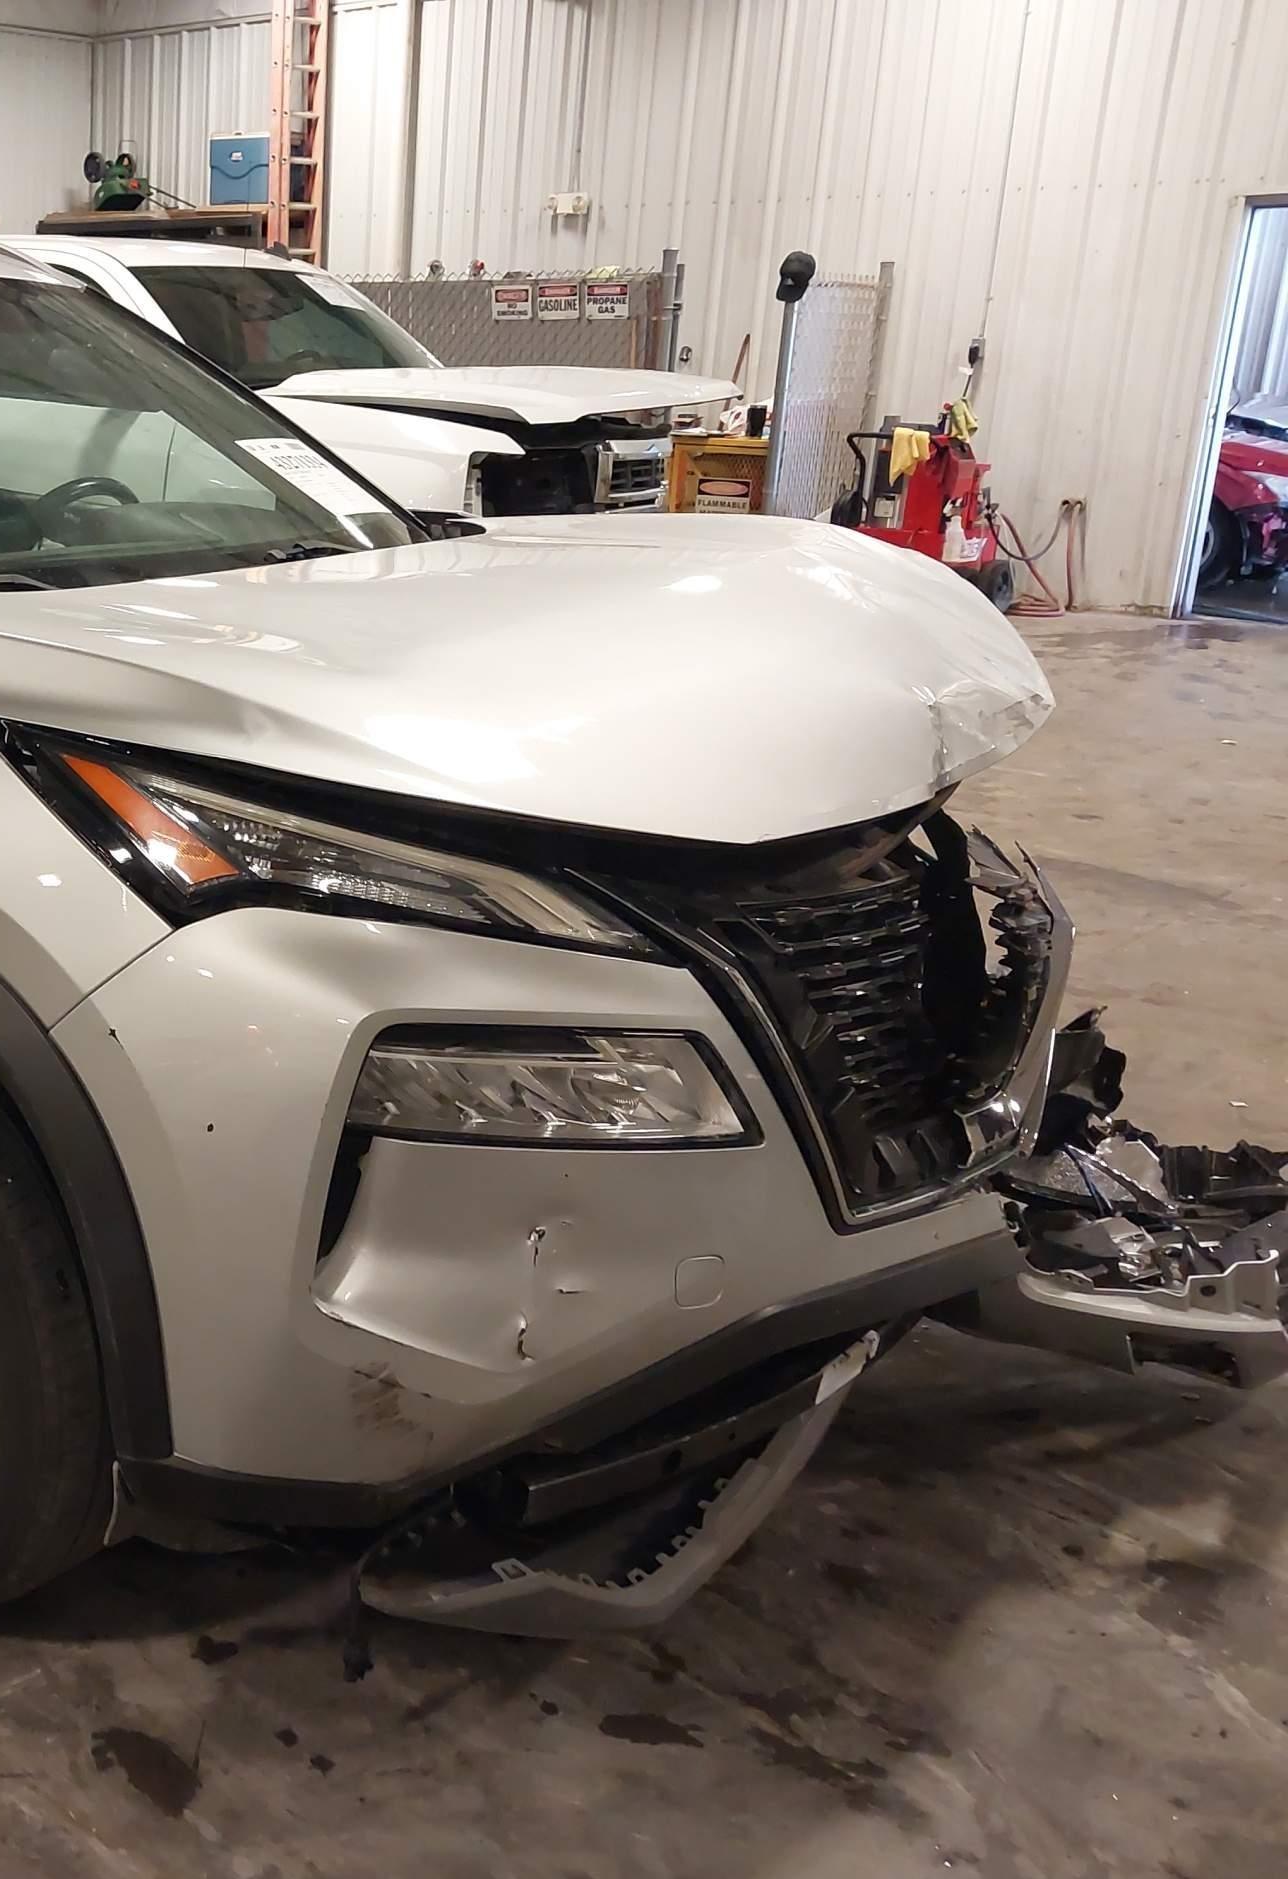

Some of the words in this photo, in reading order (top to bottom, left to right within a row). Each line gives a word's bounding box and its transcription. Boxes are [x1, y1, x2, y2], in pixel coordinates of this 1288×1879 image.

[538, 298, 578, 312] GASOLINE
[587, 296, 627, 305] PROPANE
[597, 305, 616, 314] GAS
